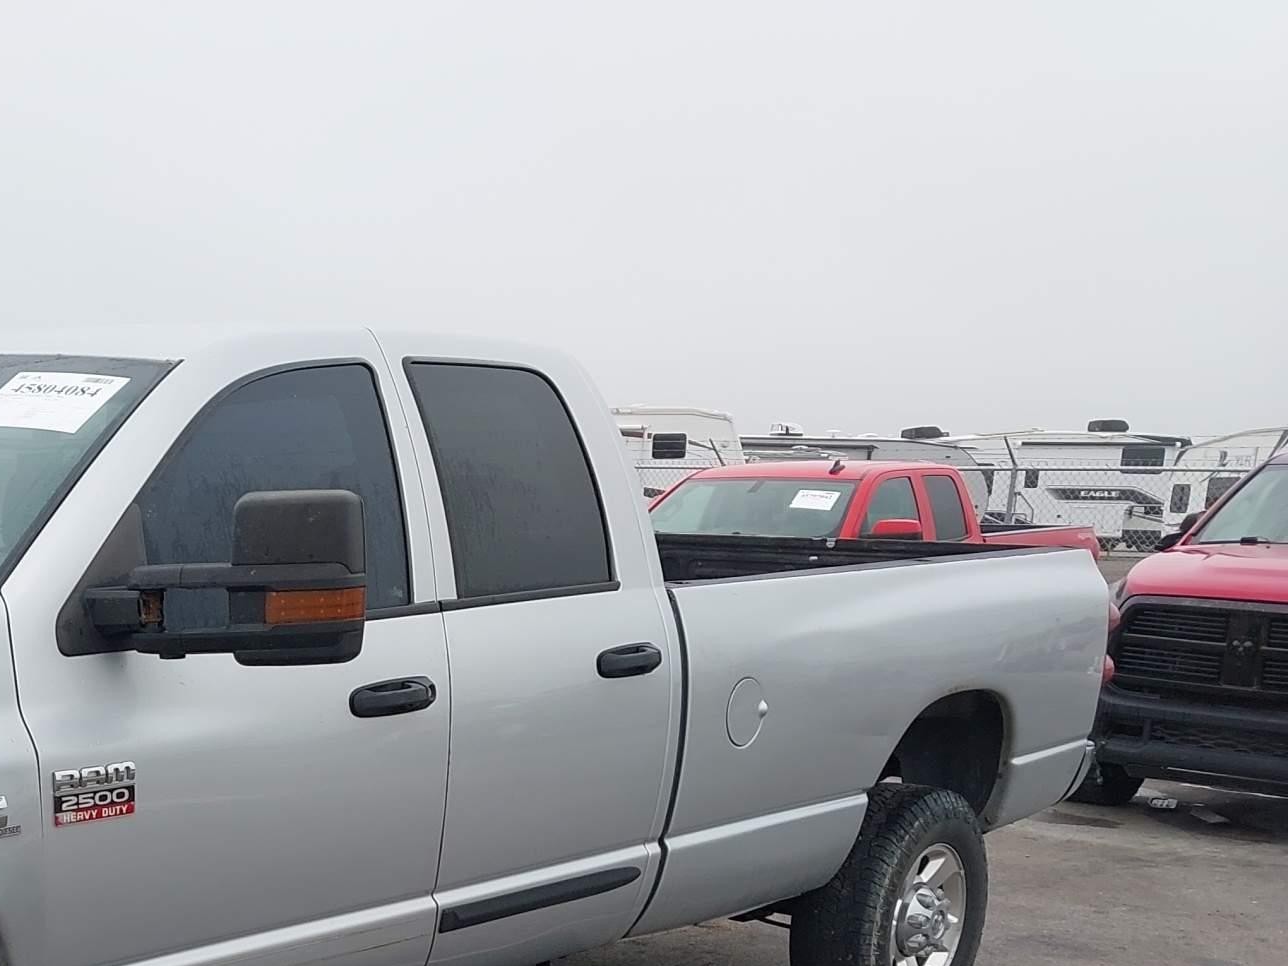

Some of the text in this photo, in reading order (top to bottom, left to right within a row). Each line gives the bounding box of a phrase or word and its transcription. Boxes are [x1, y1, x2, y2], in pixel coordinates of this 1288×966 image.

[11, 383, 103, 397] 45804084
[1080, 490, 1120, 498] EAGLE
[61, 788, 129, 811] 2500
[63, 805, 128, 824] HEAVY DUTY
